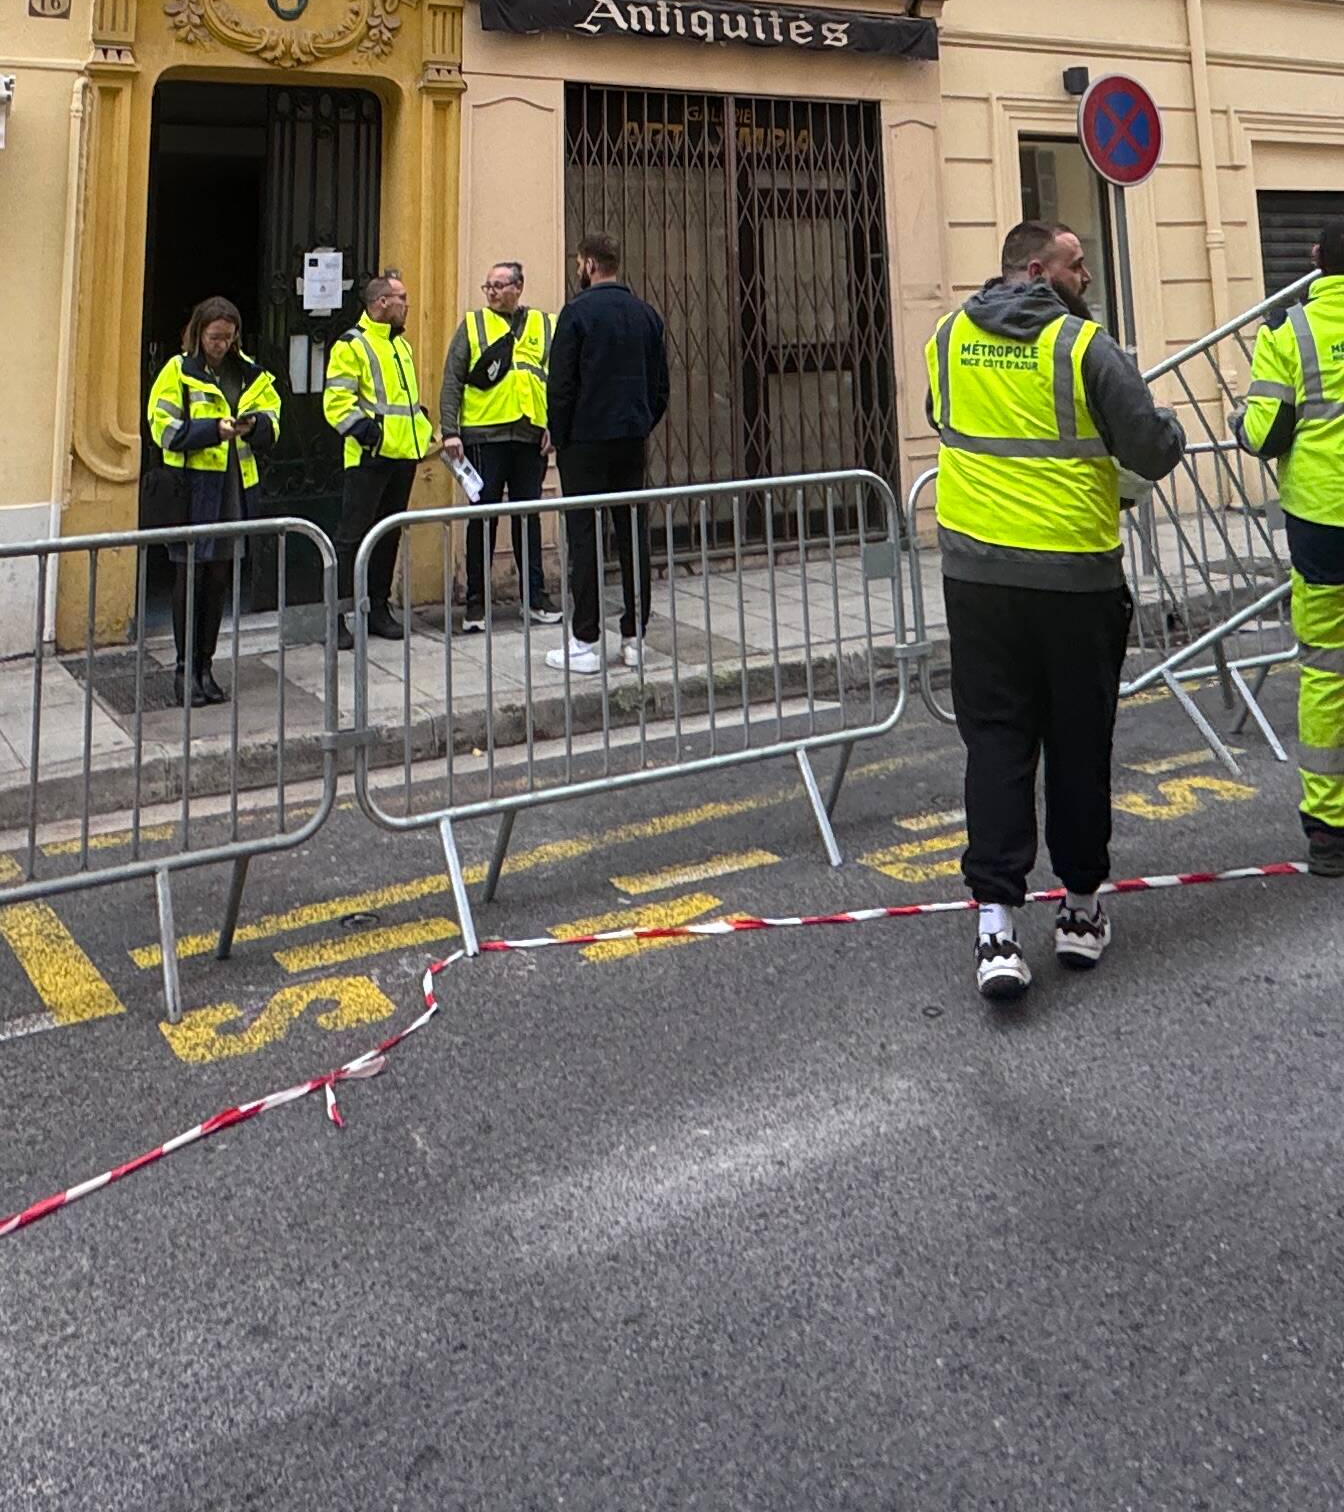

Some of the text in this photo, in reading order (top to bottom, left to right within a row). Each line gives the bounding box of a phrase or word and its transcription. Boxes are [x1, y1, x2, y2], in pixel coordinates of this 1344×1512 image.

[687, 105, 753, 124] GALRIE
[961, 339, 1039, 359] MÉTROPOLE
[960, 357, 980, 367] NICE
